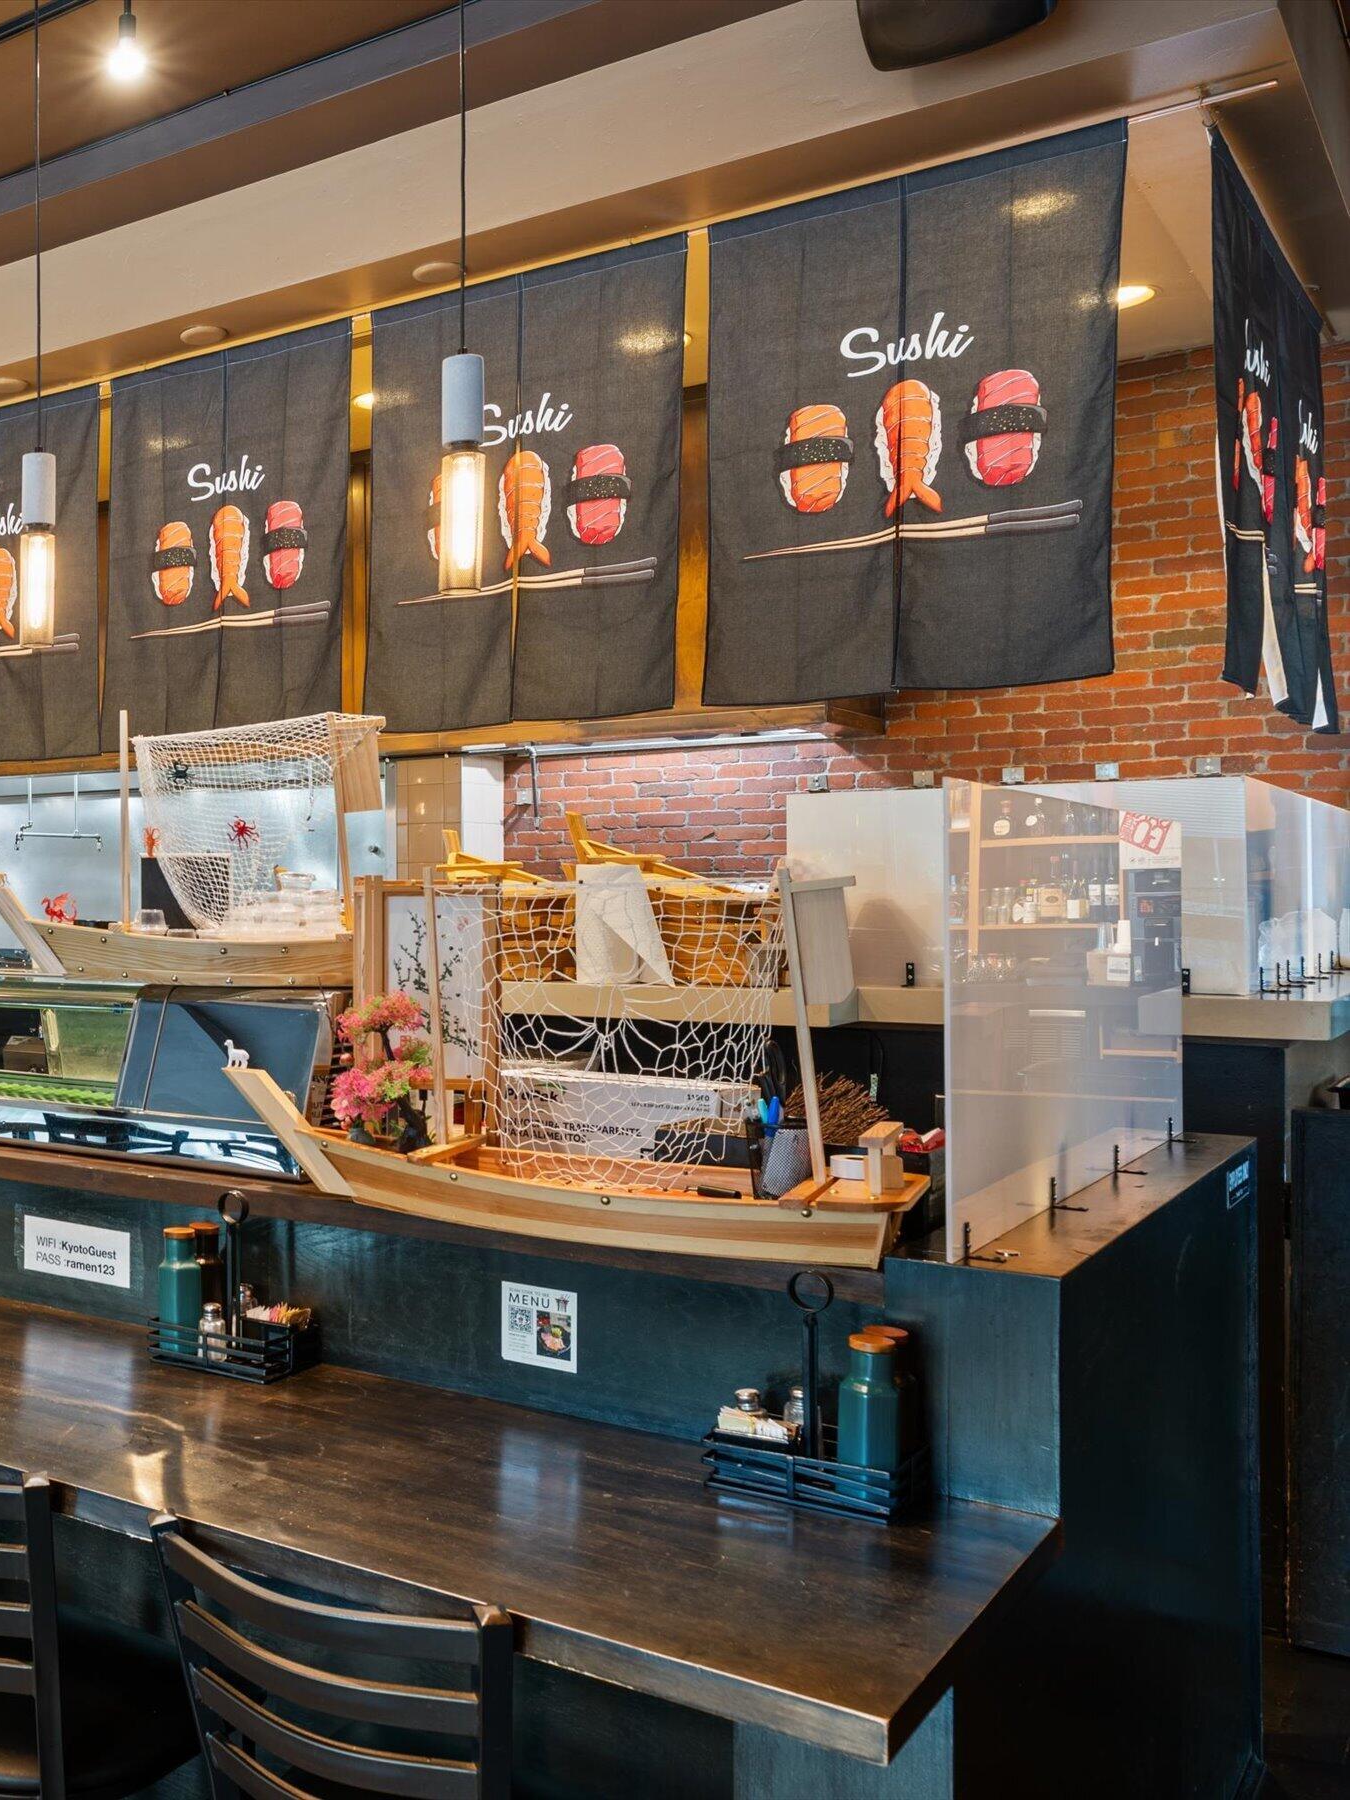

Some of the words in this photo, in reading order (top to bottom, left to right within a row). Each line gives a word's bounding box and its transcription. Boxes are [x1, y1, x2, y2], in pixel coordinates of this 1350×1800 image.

[840, 312, 974, 378] Sushi
[481, 392, 574, 447] Sushi
[187, 454, 266, 502] Sushi
[36, 1236, 56, 1248] WIFI
[36, 1252, 61, 1265] PASS
[508, 1292, 550, 1308] MENU
